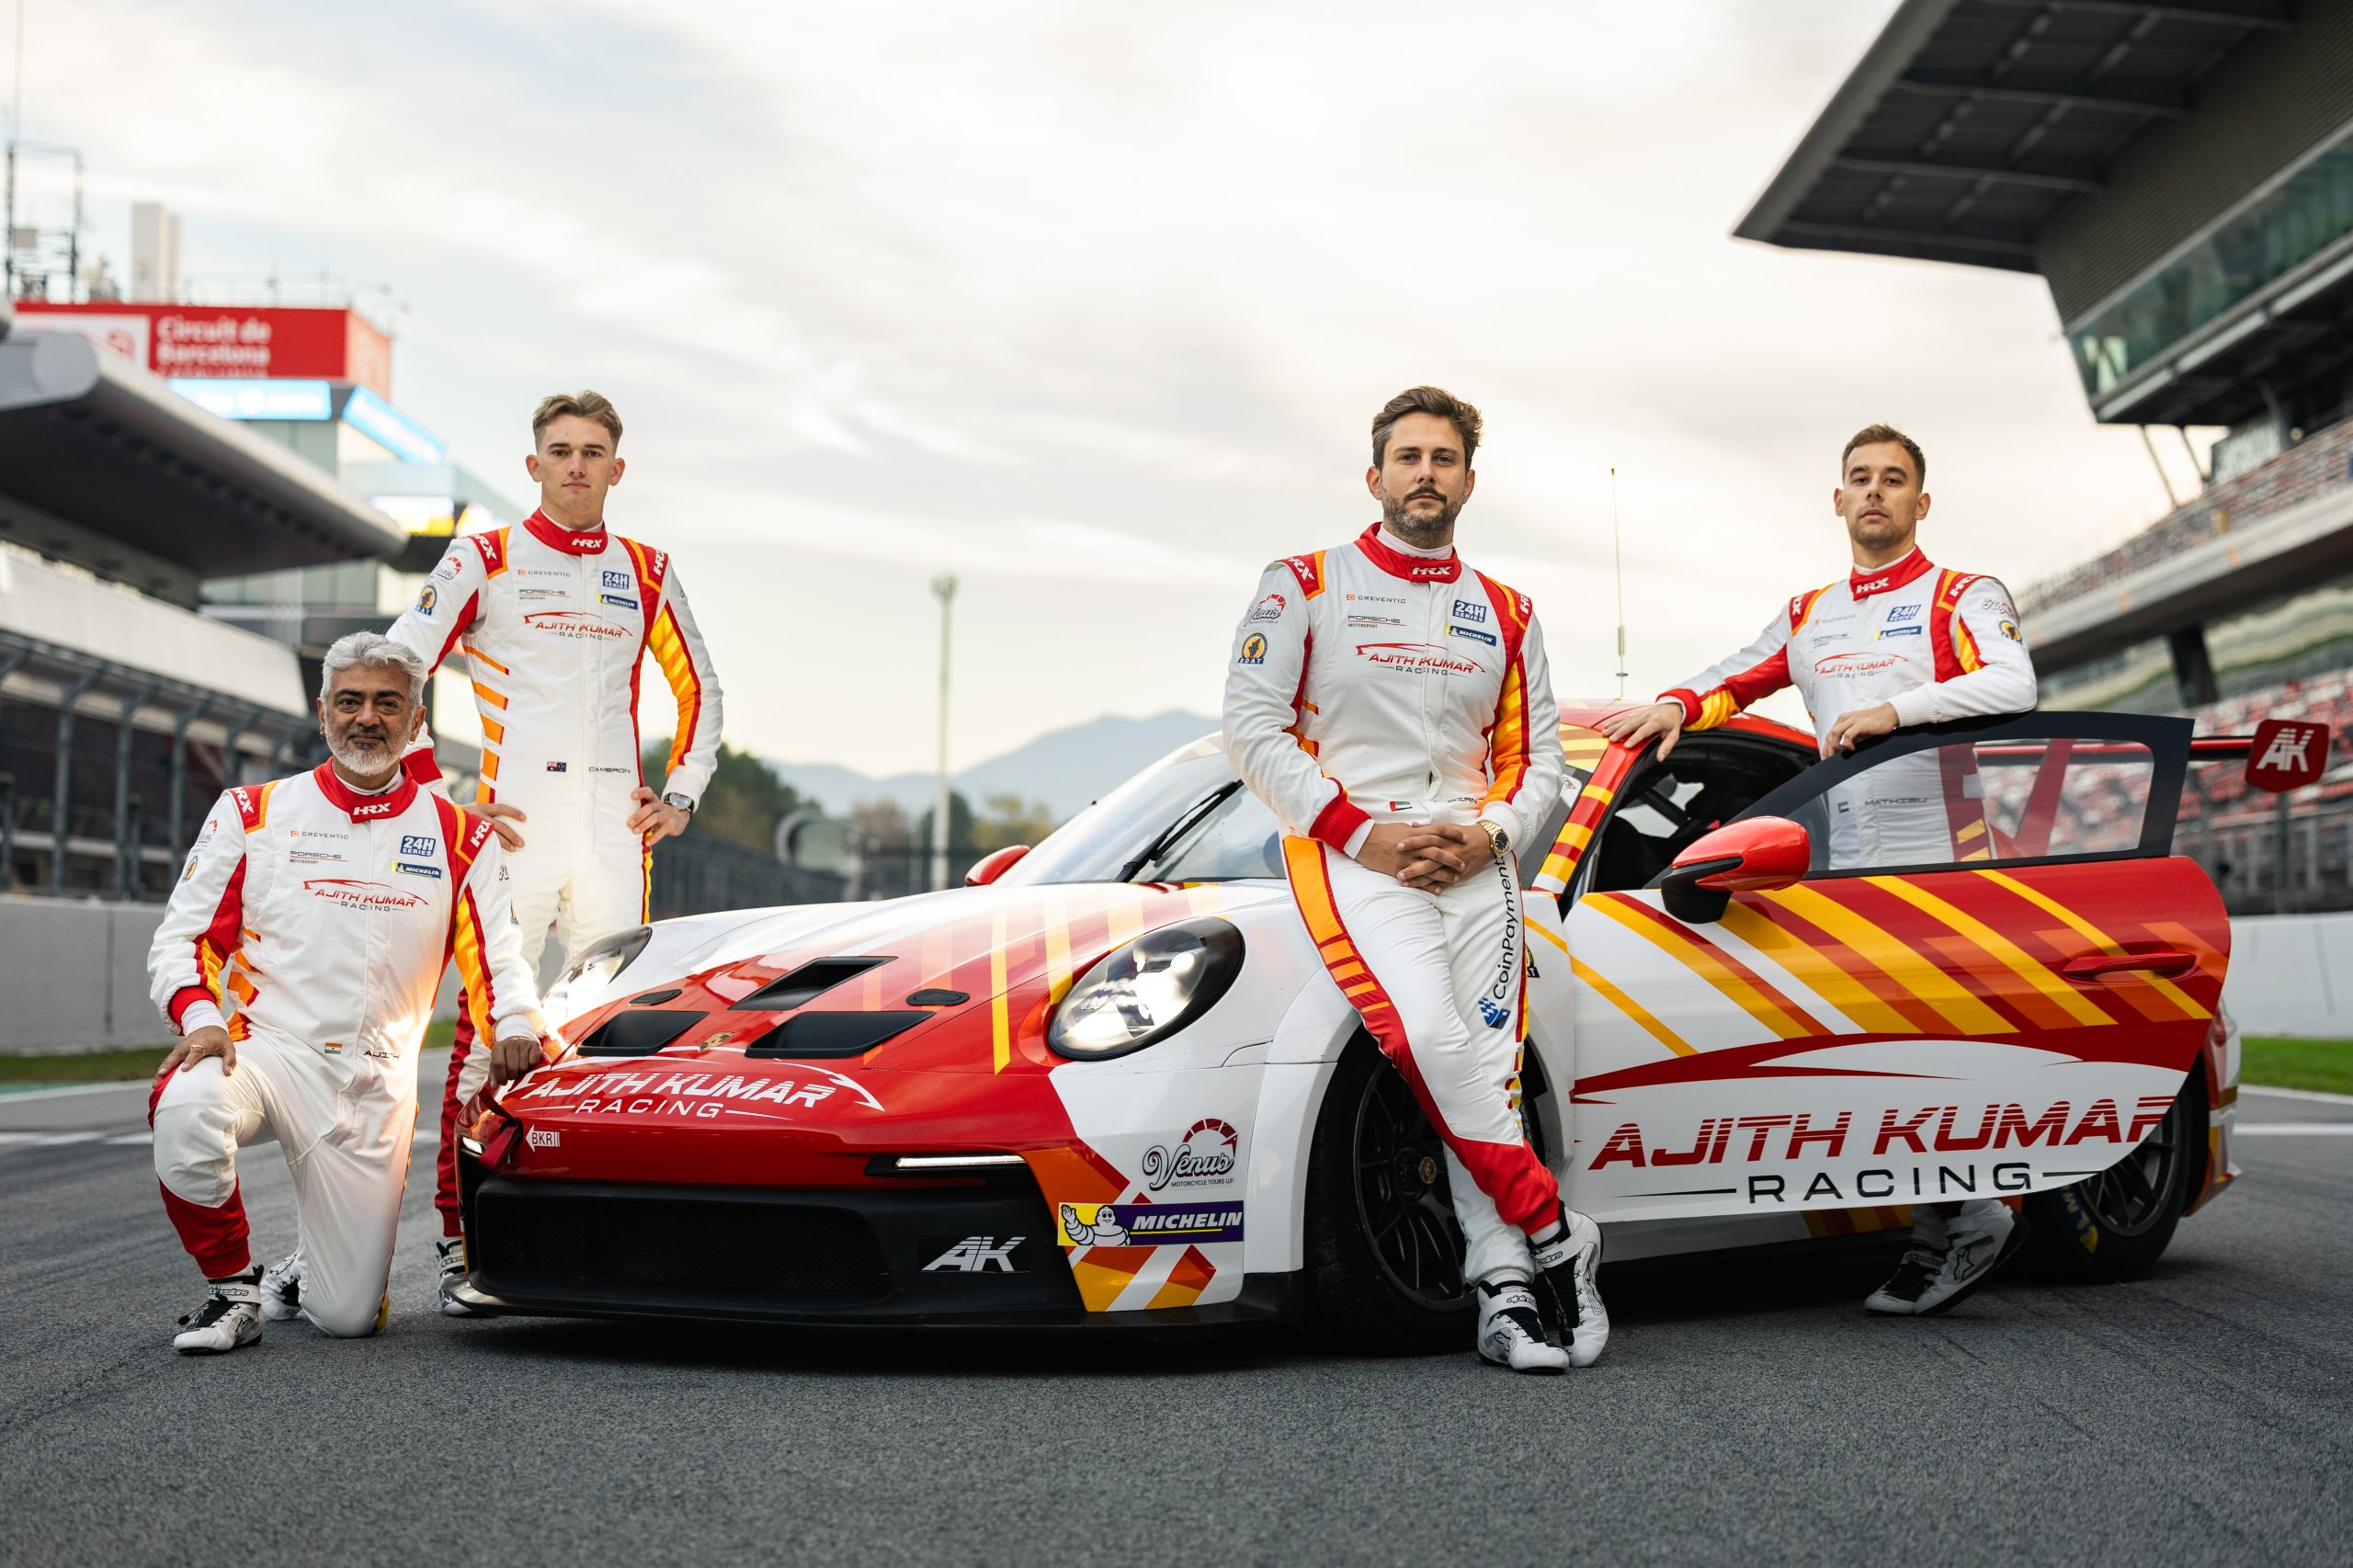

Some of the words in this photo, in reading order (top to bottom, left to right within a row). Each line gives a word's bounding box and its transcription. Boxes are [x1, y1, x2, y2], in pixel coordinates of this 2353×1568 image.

[157, 316, 236, 342] Circuit
[238, 316, 271, 344] de
[571, 539, 603, 548] HRX
[653, 550, 665, 576] HR
[1412, 566, 1452, 575] HRX
[604, 572, 628, 585] 24H
[1856, 577, 1890, 593] HRX
[608, 597, 635, 607] MICHELIN
[1455, 600, 1485, 618] 24H
[1891, 605, 1921, 618] 24H
[1347, 615, 1401, 623] PORSCHE
[1454, 611, 1483, 622] SERIES
[535, 621, 575, 631] AJITH
[579, 623, 623, 638] KUMAR
[559, 631, 603, 641] RACING
[1460, 630, 1493, 642] MICHELIN
[1369, 653, 1415, 665] AJITH
[1418, 657, 1474, 674] KUMAR
[1820, 664, 1853, 675] AJITH
[1395, 665, 1449, 676] RACING
[2256, 727, 2315, 773] AK
[1865, 797, 1927, 806] MATHIEU
[353, 802, 392, 815] HRX
[301, 831, 349, 840] CREVENTIC
[470, 820, 492, 847] HRX
[403, 836, 436, 851] 24H
[290, 850, 342, 858] PORSCHE
[402, 847, 432, 857] SERIES
[405, 866, 440, 876] MICHELIN
[315, 889, 360, 902] AJITH
[363, 895, 416, 908] KUMAR
[341, 902, 391, 912] RACING
[521, 1072, 657, 1100] AJITH
[654, 1074, 836, 1108] KUMAR
[575, 1098, 724, 1119] RACING
[1588, 1110, 1853, 1171] AJITH
[1142, 1143, 1235, 1192] Venus
[1171, 1179, 1208, 1187] MOTORCYCLE
[1748, 1162, 2032, 1204] RACING
[1132, 1211, 1243, 1230] MICHELIN
[921, 1236, 1027, 1272] AK
